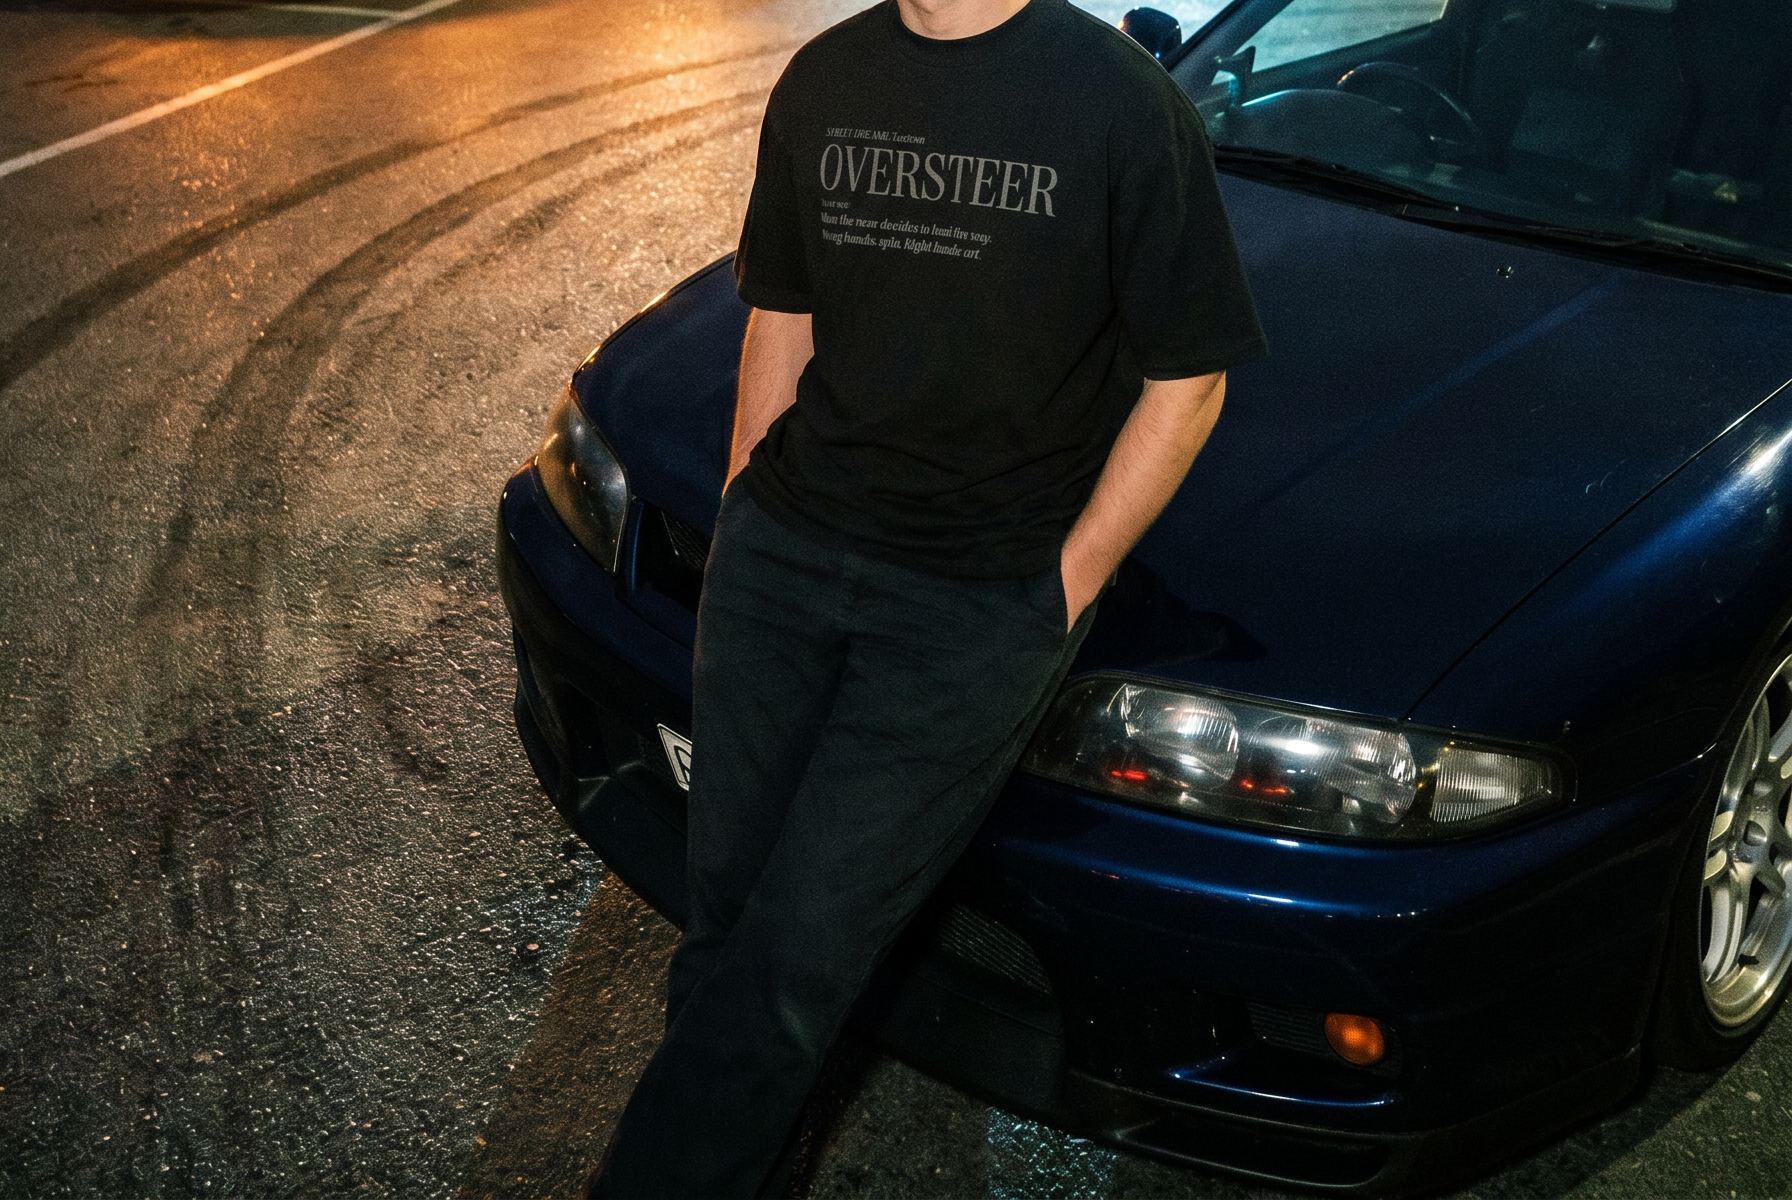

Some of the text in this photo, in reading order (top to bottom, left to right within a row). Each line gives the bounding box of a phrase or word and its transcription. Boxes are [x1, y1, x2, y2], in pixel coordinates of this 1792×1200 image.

[819, 143, 1058, 218] OVERSTEER
[839, 214, 855, 226] the
[879, 217, 919, 234] decides
